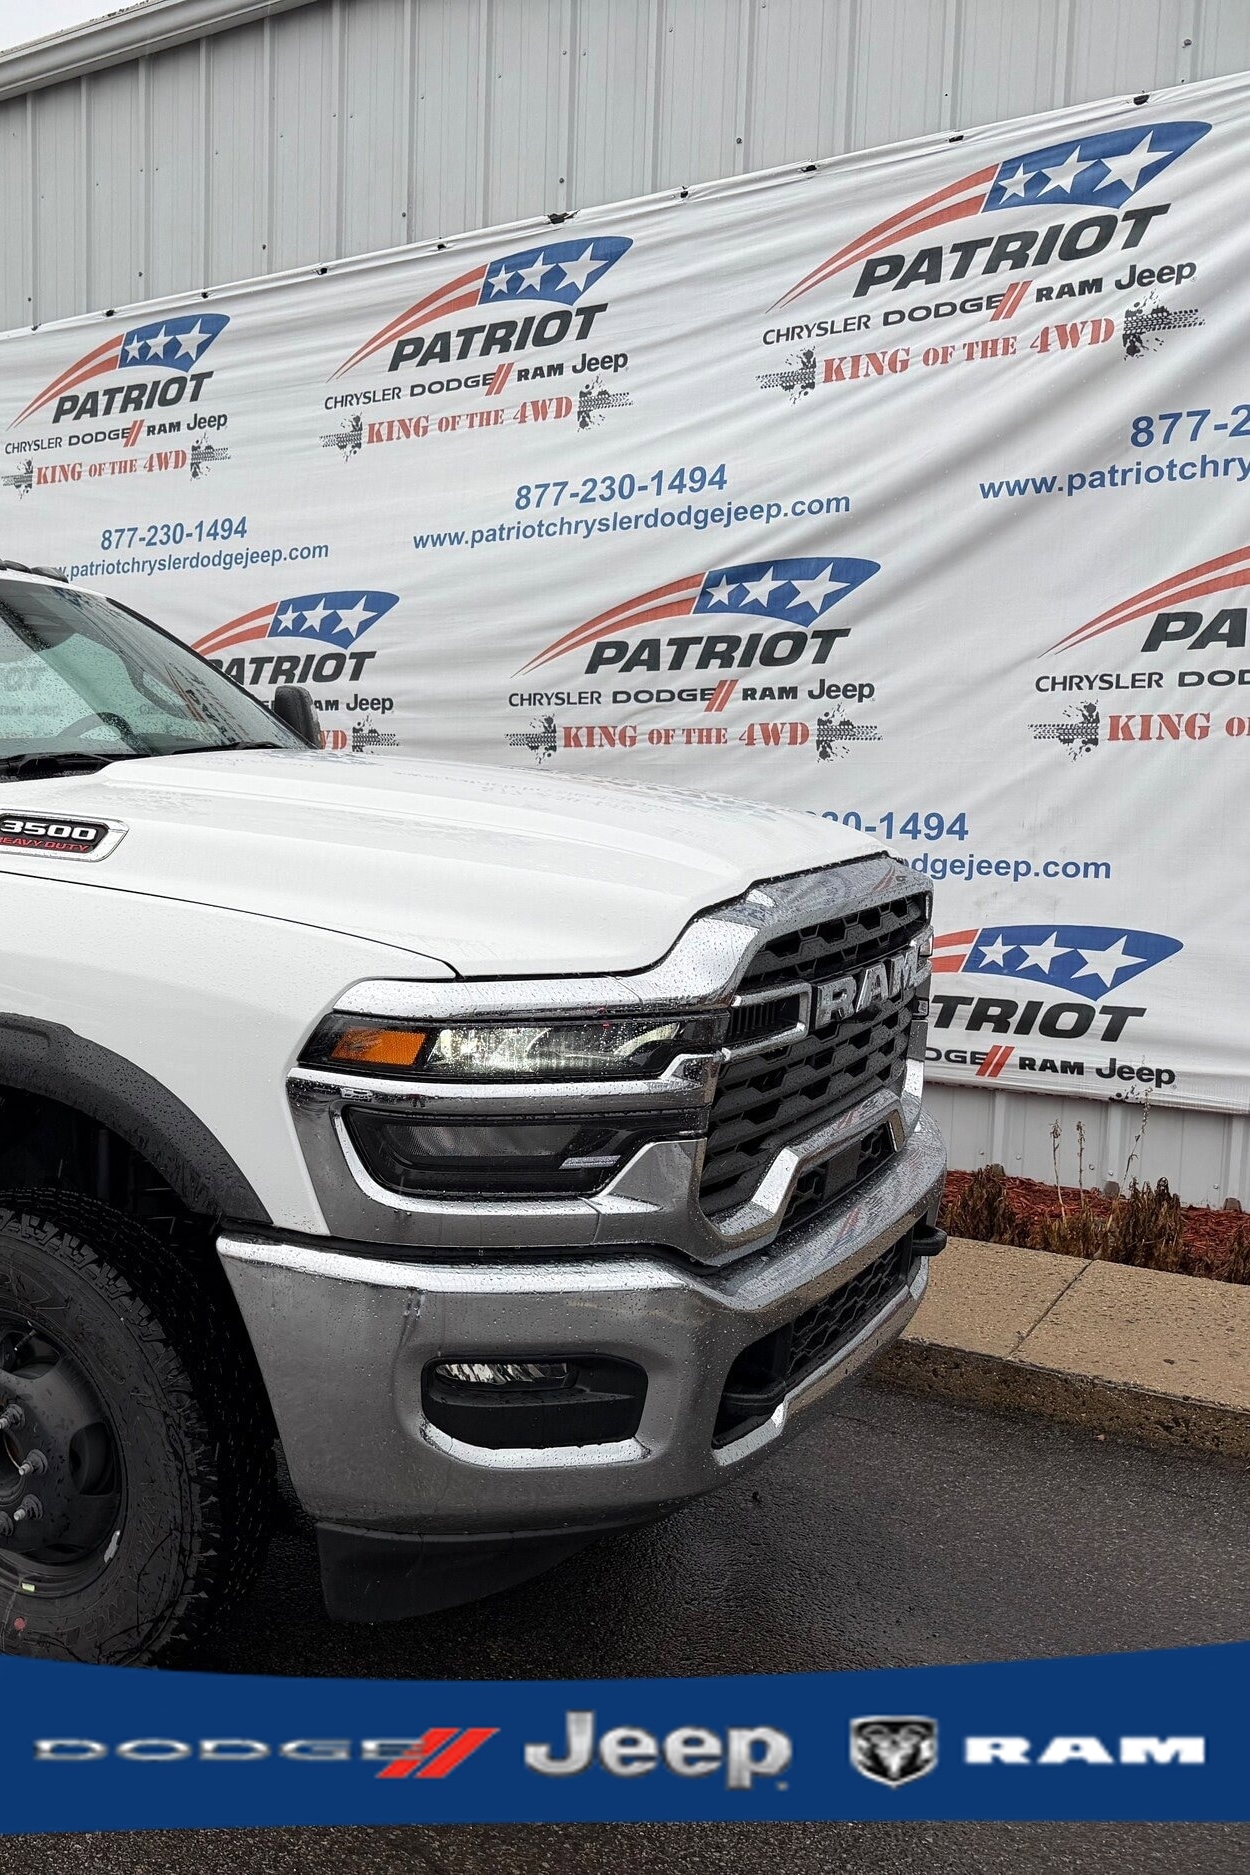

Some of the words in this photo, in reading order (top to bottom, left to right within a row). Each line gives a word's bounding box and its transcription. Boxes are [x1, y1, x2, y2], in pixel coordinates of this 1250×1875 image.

[852, 203, 1171, 298] PATRIOT
[762, 314, 870, 346] CHRYSLER
[882, 293, 1002, 328] DODGE
[1035, 278, 1103, 303] RAM
[1114, 260, 1197, 291] Jeep
[387, 303, 608, 372] PATRIOT
[822, 347, 910, 383] KING
[922, 344, 956, 367] OF
[962, 336, 1017, 362] THE
[1029, 317, 1115, 354] 4WD
[52, 371, 214, 424] PATRIOT
[324, 386, 402, 410] CHRYSLER
[409, 373, 495, 397] DODGE
[517, 363, 564, 383] RAM
[572, 352, 629, 375] Jeep
[5, 437, 63, 454] CHRYSLER
[68, 428, 131, 447] DODGE
[146, 421, 181, 436] RAM
[186, 413, 228, 431] Jeep
[366, 415, 429, 444] KING
[437, 414, 463, 433] OF
[466, 408, 505, 430] THE
[513, 396, 573, 425] 4WD
[36, 462, 82, 485] KING
[88, 463, 107, 477] OF
[108, 459, 137, 475] THE
[143, 450, 187, 472] 4WD
[515, 463, 728, 510] 877-230-1494
[101, 516, 247, 550] 877-230-1494
[413, 495, 850, 549] www.patriotchryslerdodgejeep.com
[584, 628, 851, 674] PATRIOT
[314, 699, 339, 711] AM
[346, 694, 394, 714] Jeep
[509, 691, 602, 707] CHRYSLER
[612, 688, 716, 704] DODGE
[742, 686, 798, 701] RAM
[808, 678, 875, 703] Jeep
[1035, 671, 1163, 692] CHRYSLER
[562, 725, 637, 748] KING
[648, 727, 675, 746] OF
[681, 727, 728, 745] THE
[739, 722, 810, 746] 4WD
[1108, 712, 1211, 742] KING
[0, 820, 97, 840] 3500
[45, 842, 89, 852] DUTY
[815, 947, 919, 1029] RAM
[931, 995, 1147, 1042] TRIOT
[1019, 1056, 1084, 1076] RAM
[1096, 1058, 1175, 1088] Jeep
